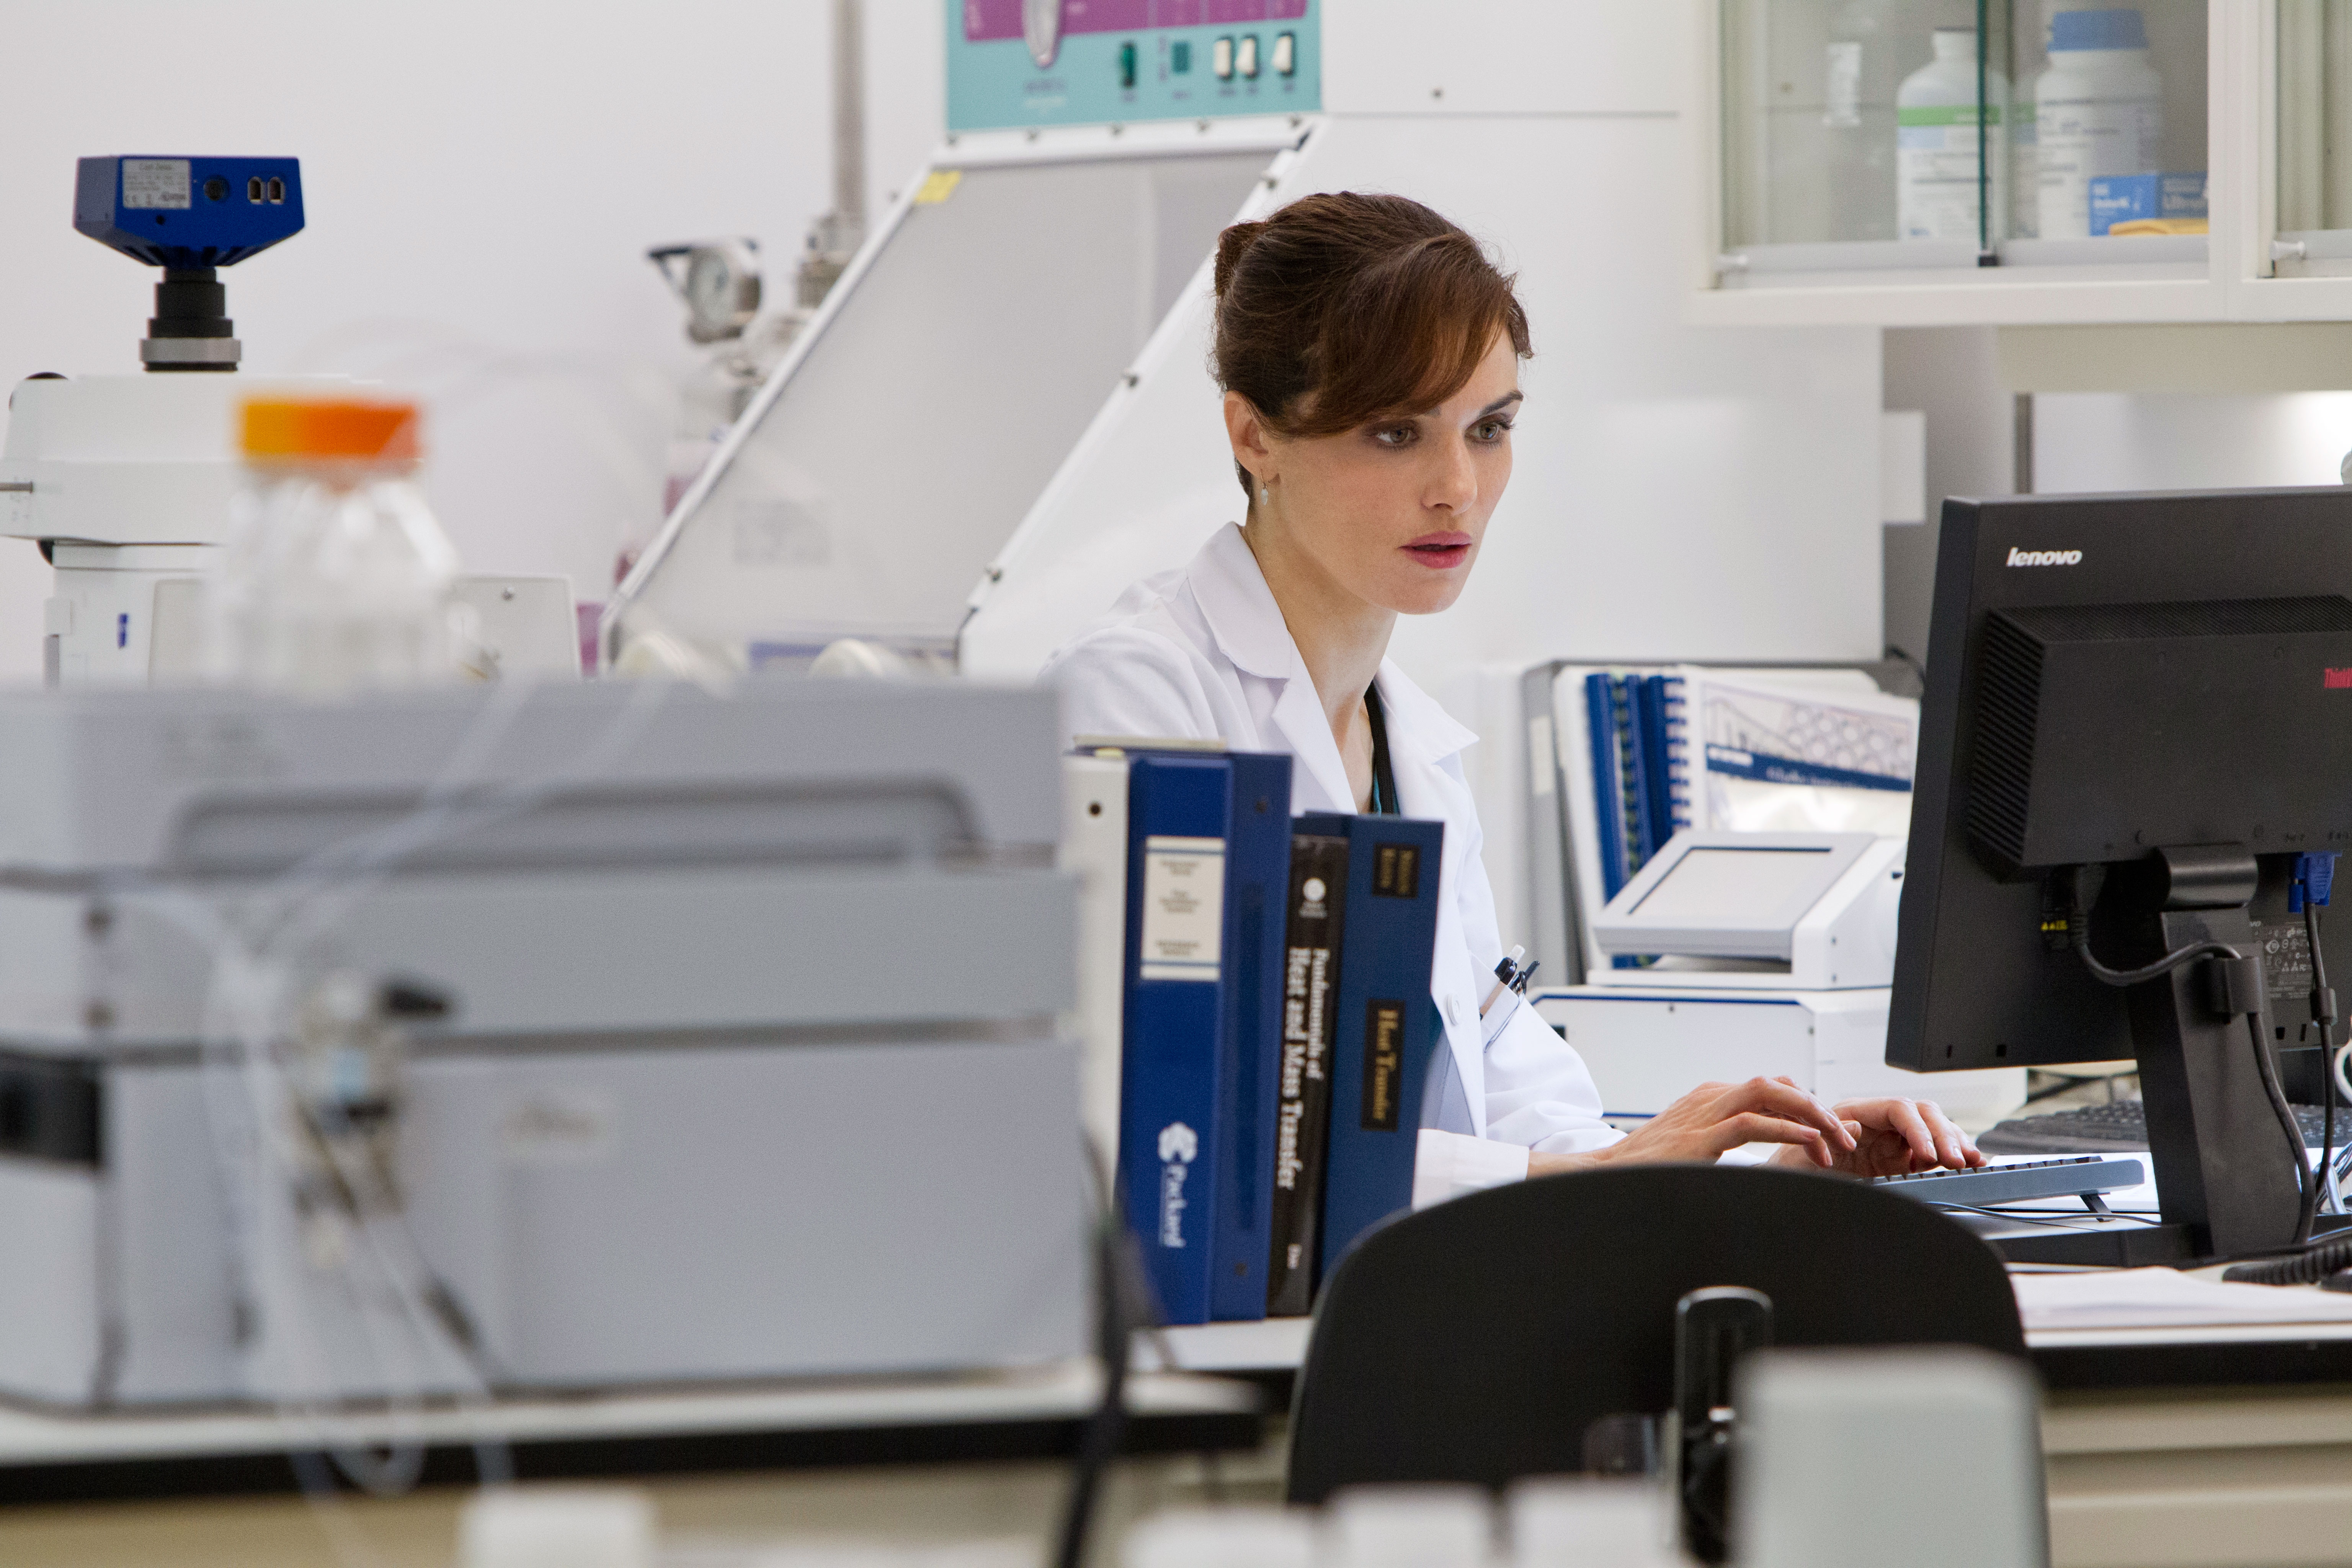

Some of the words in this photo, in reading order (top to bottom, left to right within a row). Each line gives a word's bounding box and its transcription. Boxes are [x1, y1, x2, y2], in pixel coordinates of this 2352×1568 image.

[2006, 547, 2082, 567] lenovo
[1288, 947, 1312, 996] Heat
[1285, 999, 1308, 1040] and
[1308, 947, 1330, 1058] Fundamentals
[1377, 1009, 1399, 1051] Heat
[1283, 1043, 1306, 1098] Mass
[1306, 1059, 1325, 1080] of
[1374, 1052, 1397, 1120] Transfer
[1278, 1101, 1304, 1190] Transfer
